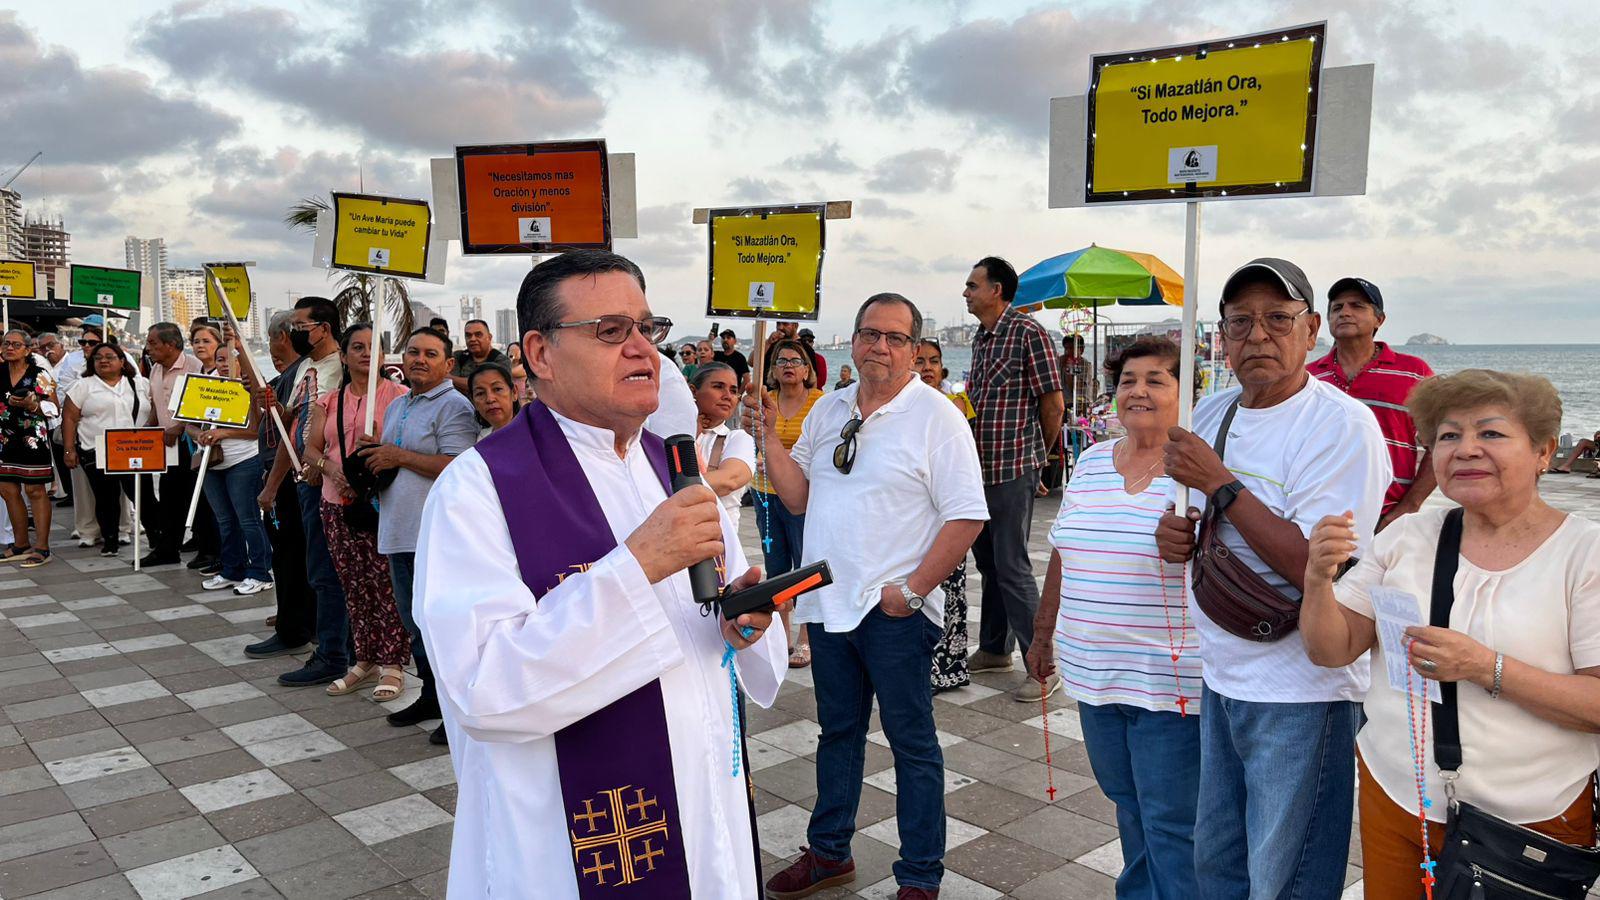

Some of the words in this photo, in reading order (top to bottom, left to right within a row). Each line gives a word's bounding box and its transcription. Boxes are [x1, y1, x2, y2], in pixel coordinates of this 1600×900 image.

[1155, 78, 1222, 99] Mazatlán
[1227, 74, 1262, 91] Ora,
[1141, 106, 1178, 124] Todo
[488, 171, 552, 182] “Necesitamos
[493, 187, 530, 198] Oración
[531, 189, 538, 199] y
[539, 187, 571, 196] menos
[362, 213, 374, 223] Ave
[394, 219, 416, 227] puede
[354, 226, 380, 235] cambiar
[382, 228, 389, 236] tu
[744, 234, 779, 247] Mazatlán
[780, 234, 798, 248] Ora,
[737, 252, 755, 264] Todo
